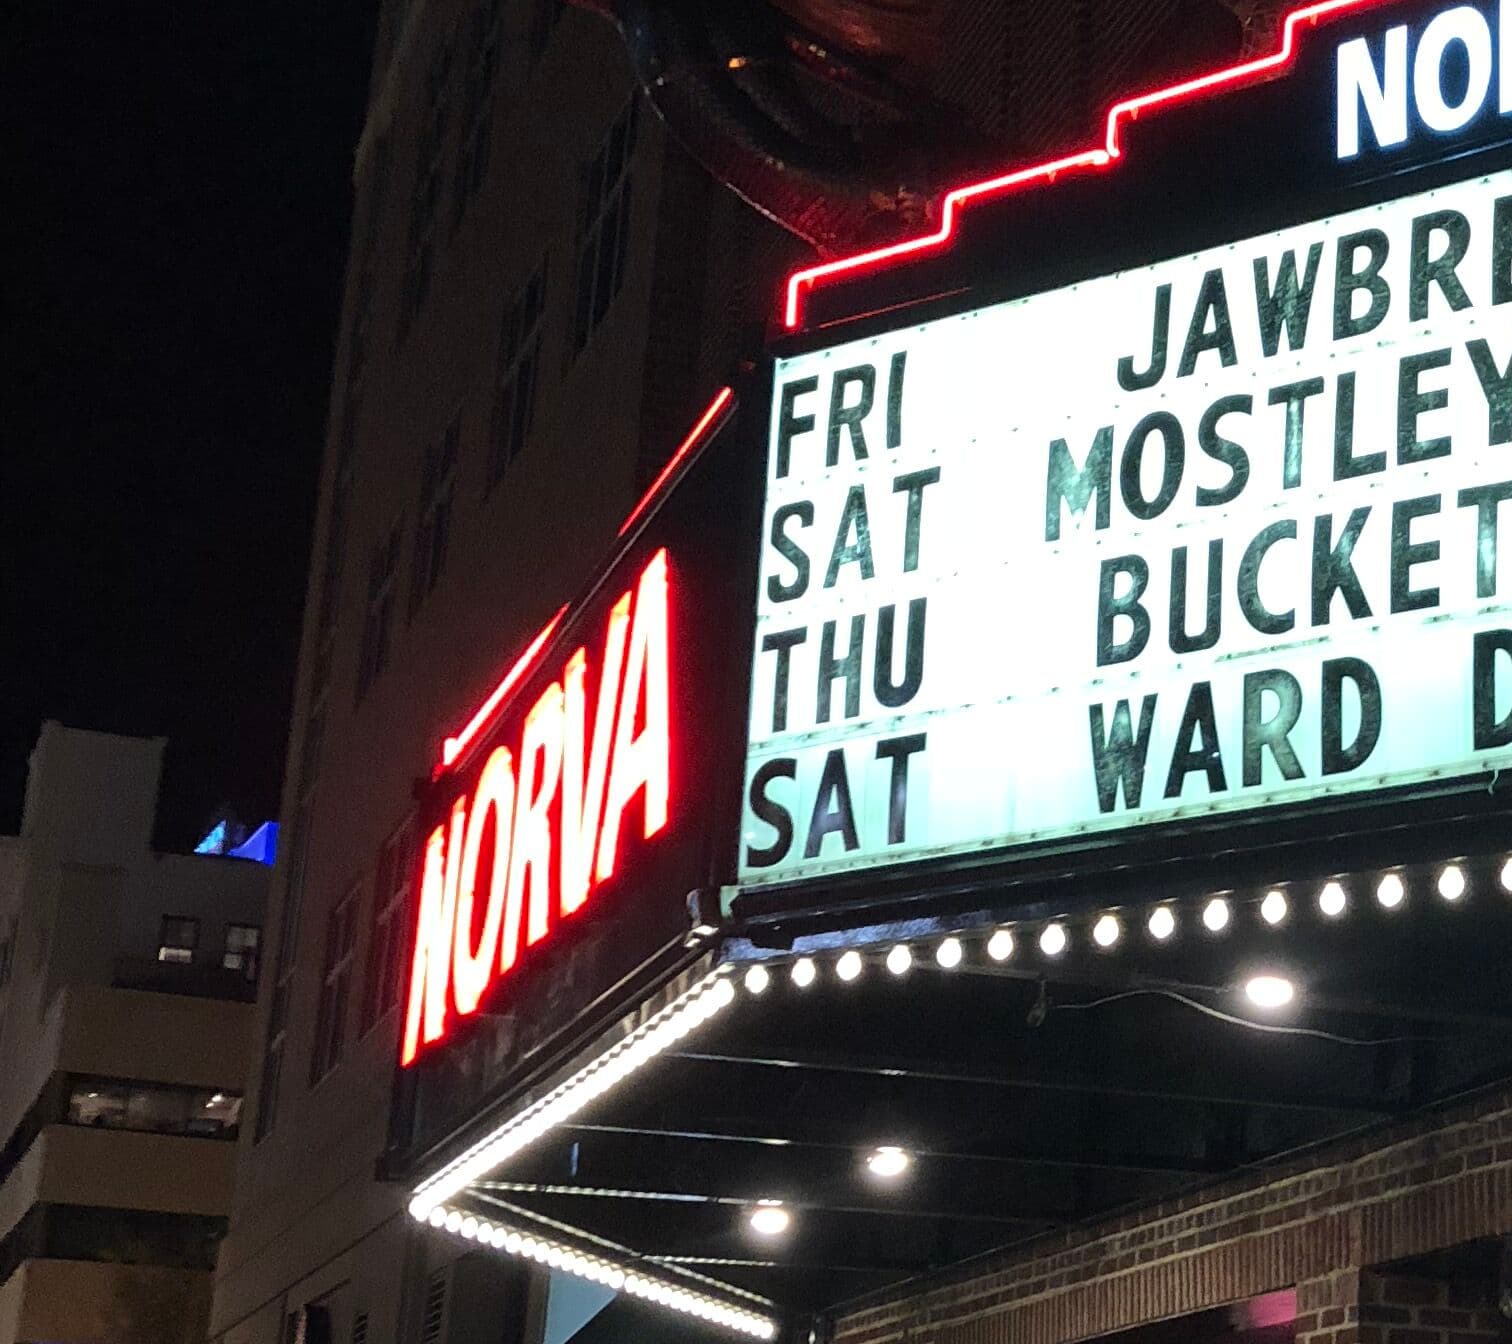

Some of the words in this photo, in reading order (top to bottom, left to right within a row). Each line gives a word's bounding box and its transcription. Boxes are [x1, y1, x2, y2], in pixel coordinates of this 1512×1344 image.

[777, 350, 908, 479] FRI
[766, 466, 941, 605] SAT
[761, 597, 928, 734] THU
[745, 732, 928, 869] SAT
[1088, 656, 1384, 815] WARD
[401, 546, 670, 1067] NORVA
